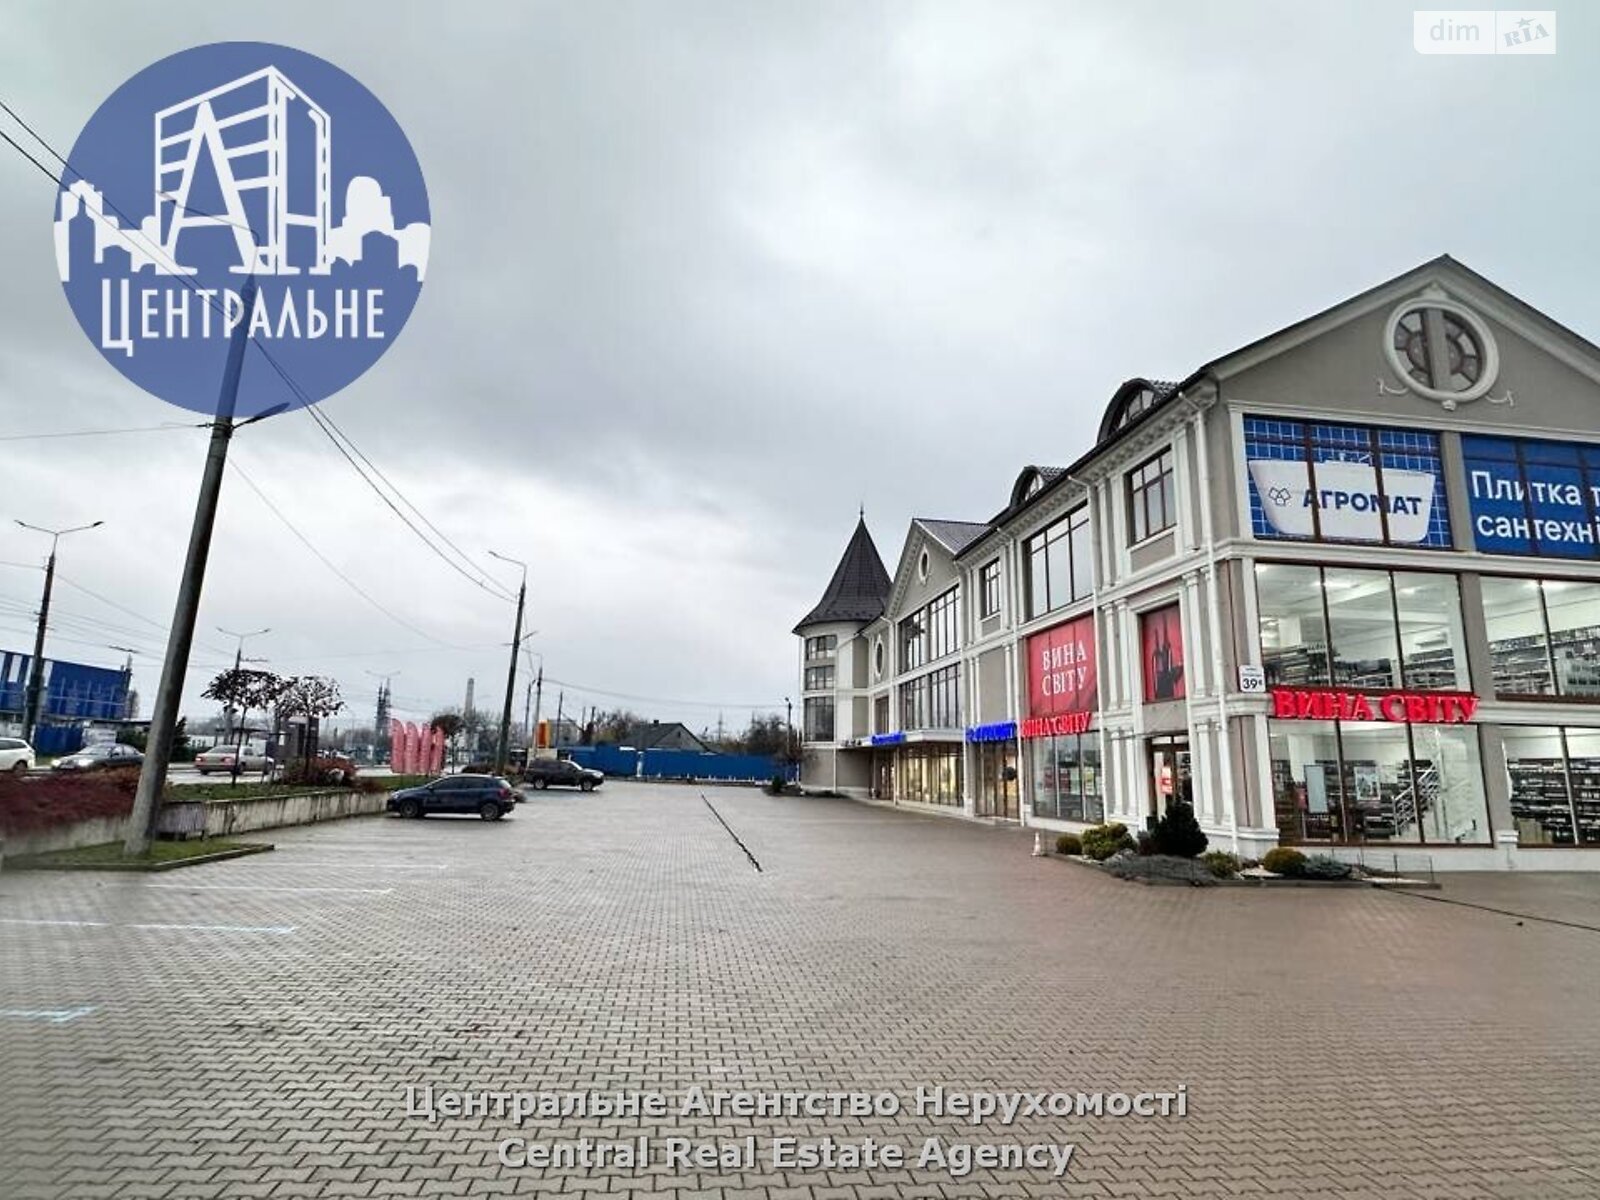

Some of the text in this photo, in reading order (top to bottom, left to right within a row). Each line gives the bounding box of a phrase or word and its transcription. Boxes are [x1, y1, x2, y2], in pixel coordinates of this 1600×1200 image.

[1471, 470, 1582, 506] Плитка
[1043, 640, 1087, 671] ВИНА
[1042, 666, 1087, 696] СВІТУ
[1273, 690, 1479, 722] ВИНА СВІТУ
